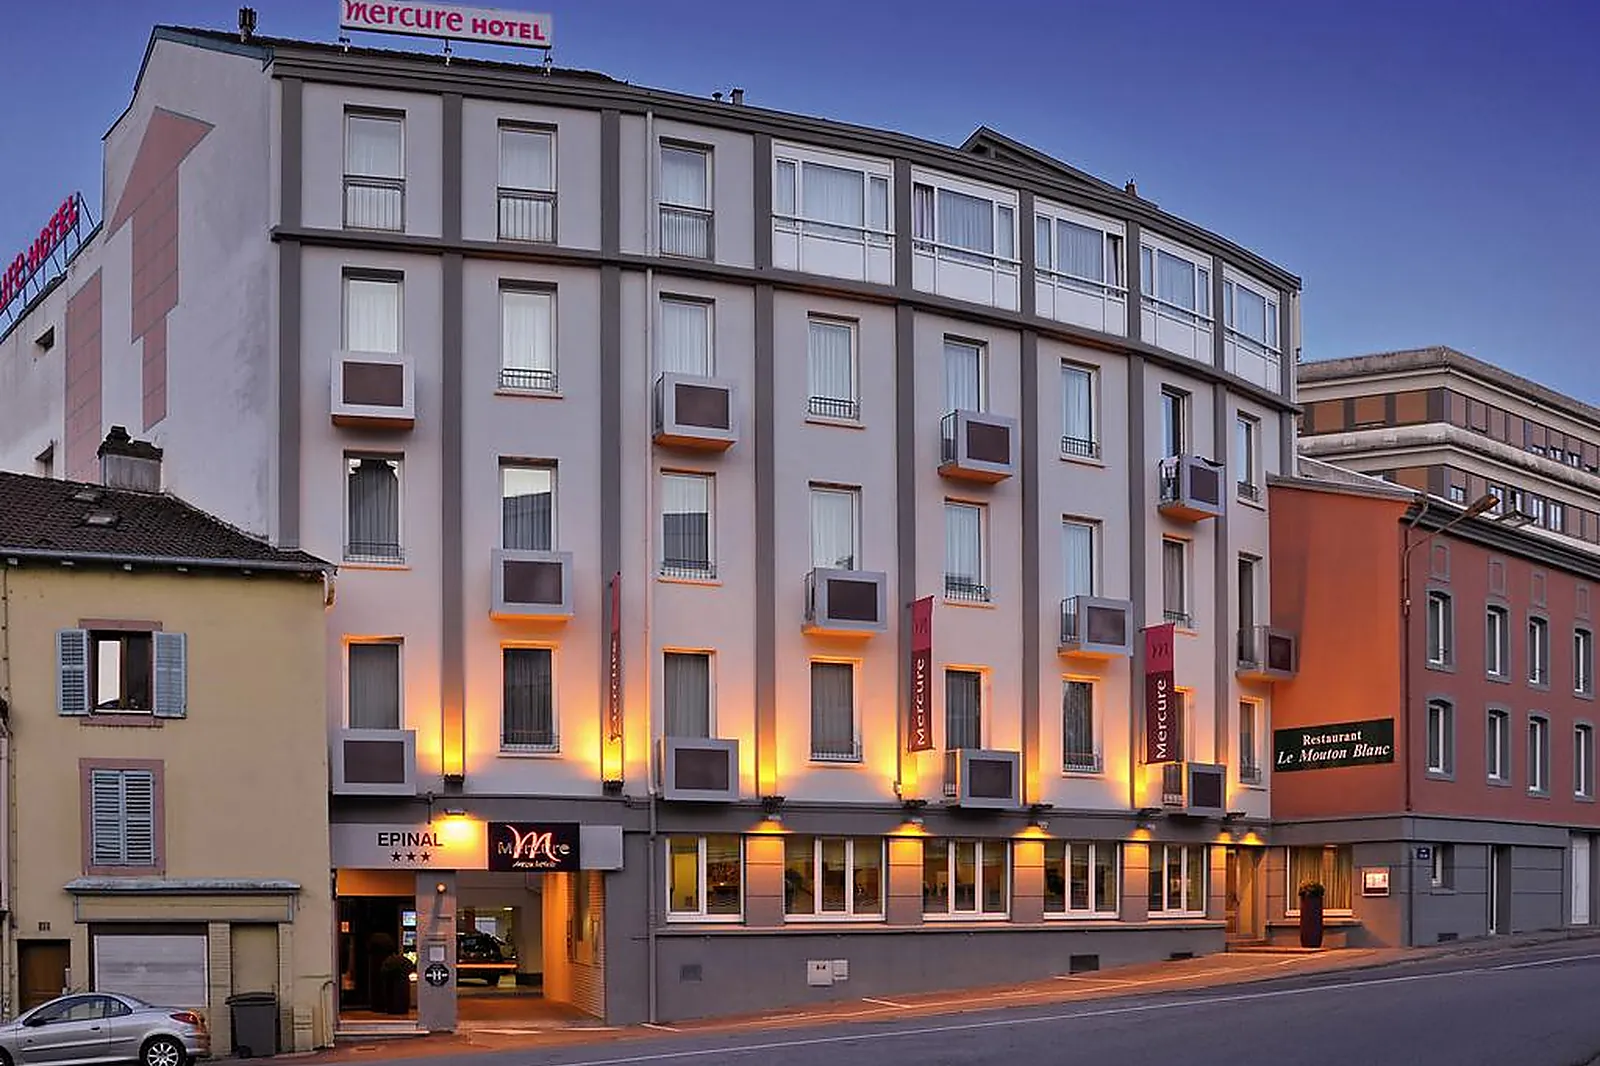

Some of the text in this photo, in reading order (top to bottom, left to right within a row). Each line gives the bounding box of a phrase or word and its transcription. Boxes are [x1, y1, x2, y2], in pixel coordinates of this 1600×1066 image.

[344, 0, 545, 41] mercure HOTEL
[28, 195, 77, 273] HOTEL
[916, 658, 926, 746] Mercure
[1156, 678, 1168, 759] Mercure
[1277, 743, 1390, 765] Le Mouton Blanc
[1302, 730, 1362, 746] Restaurant
[377, 831, 444, 848] EPINAL
